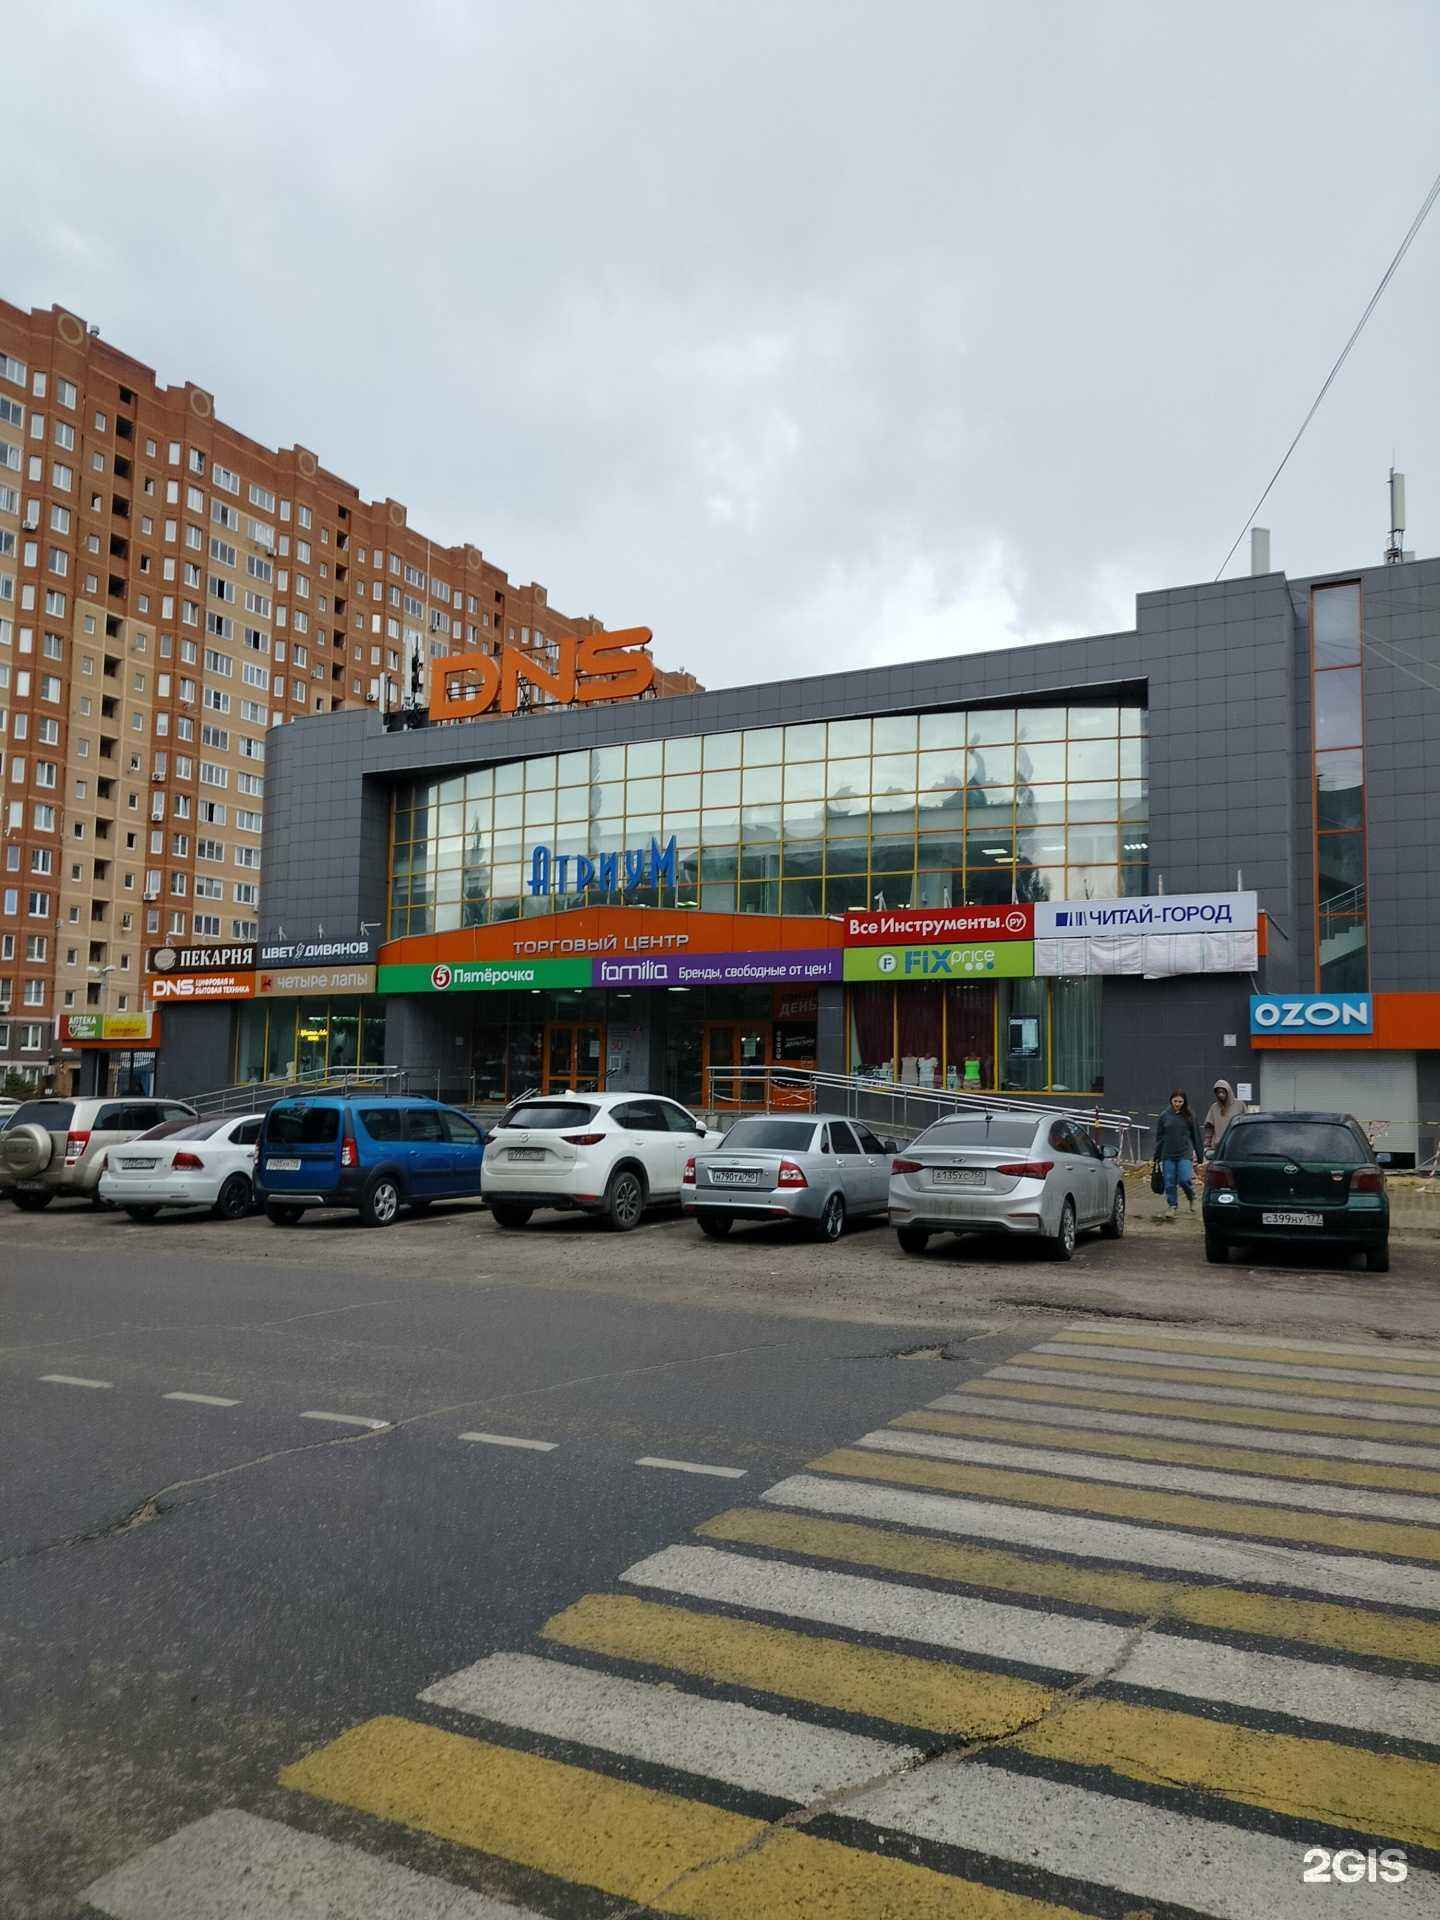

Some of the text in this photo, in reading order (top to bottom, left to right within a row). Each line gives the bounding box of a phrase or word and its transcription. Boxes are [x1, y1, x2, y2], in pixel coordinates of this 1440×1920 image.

[428, 626, 656, 721] DNS
[1089, 903, 1233, 926] ЧИТАЙ-ГОРОД
[261, 946, 295, 960] ЦВЕТ
[304, 941, 369, 958] ДИВАНОВ
[513, 934, 689, 954] ТОРГОВЫЙ ЦЕНТР
[180, 947, 253, 967] ПЕКАРНЯ
[330, 972, 369, 986] лапы
[453, 967, 535, 986] Пятёрочка
[601, 960, 668, 981] familia
[678, 966, 722, 980] Бренды,
[724, 964, 786, 978] свободные
[789, 964, 802, 976] от
[153, 978, 195, 997] DNS
[68, 1015, 97, 1025] АПТЕКА
[1255, 1001, 1368, 1026] OZON
